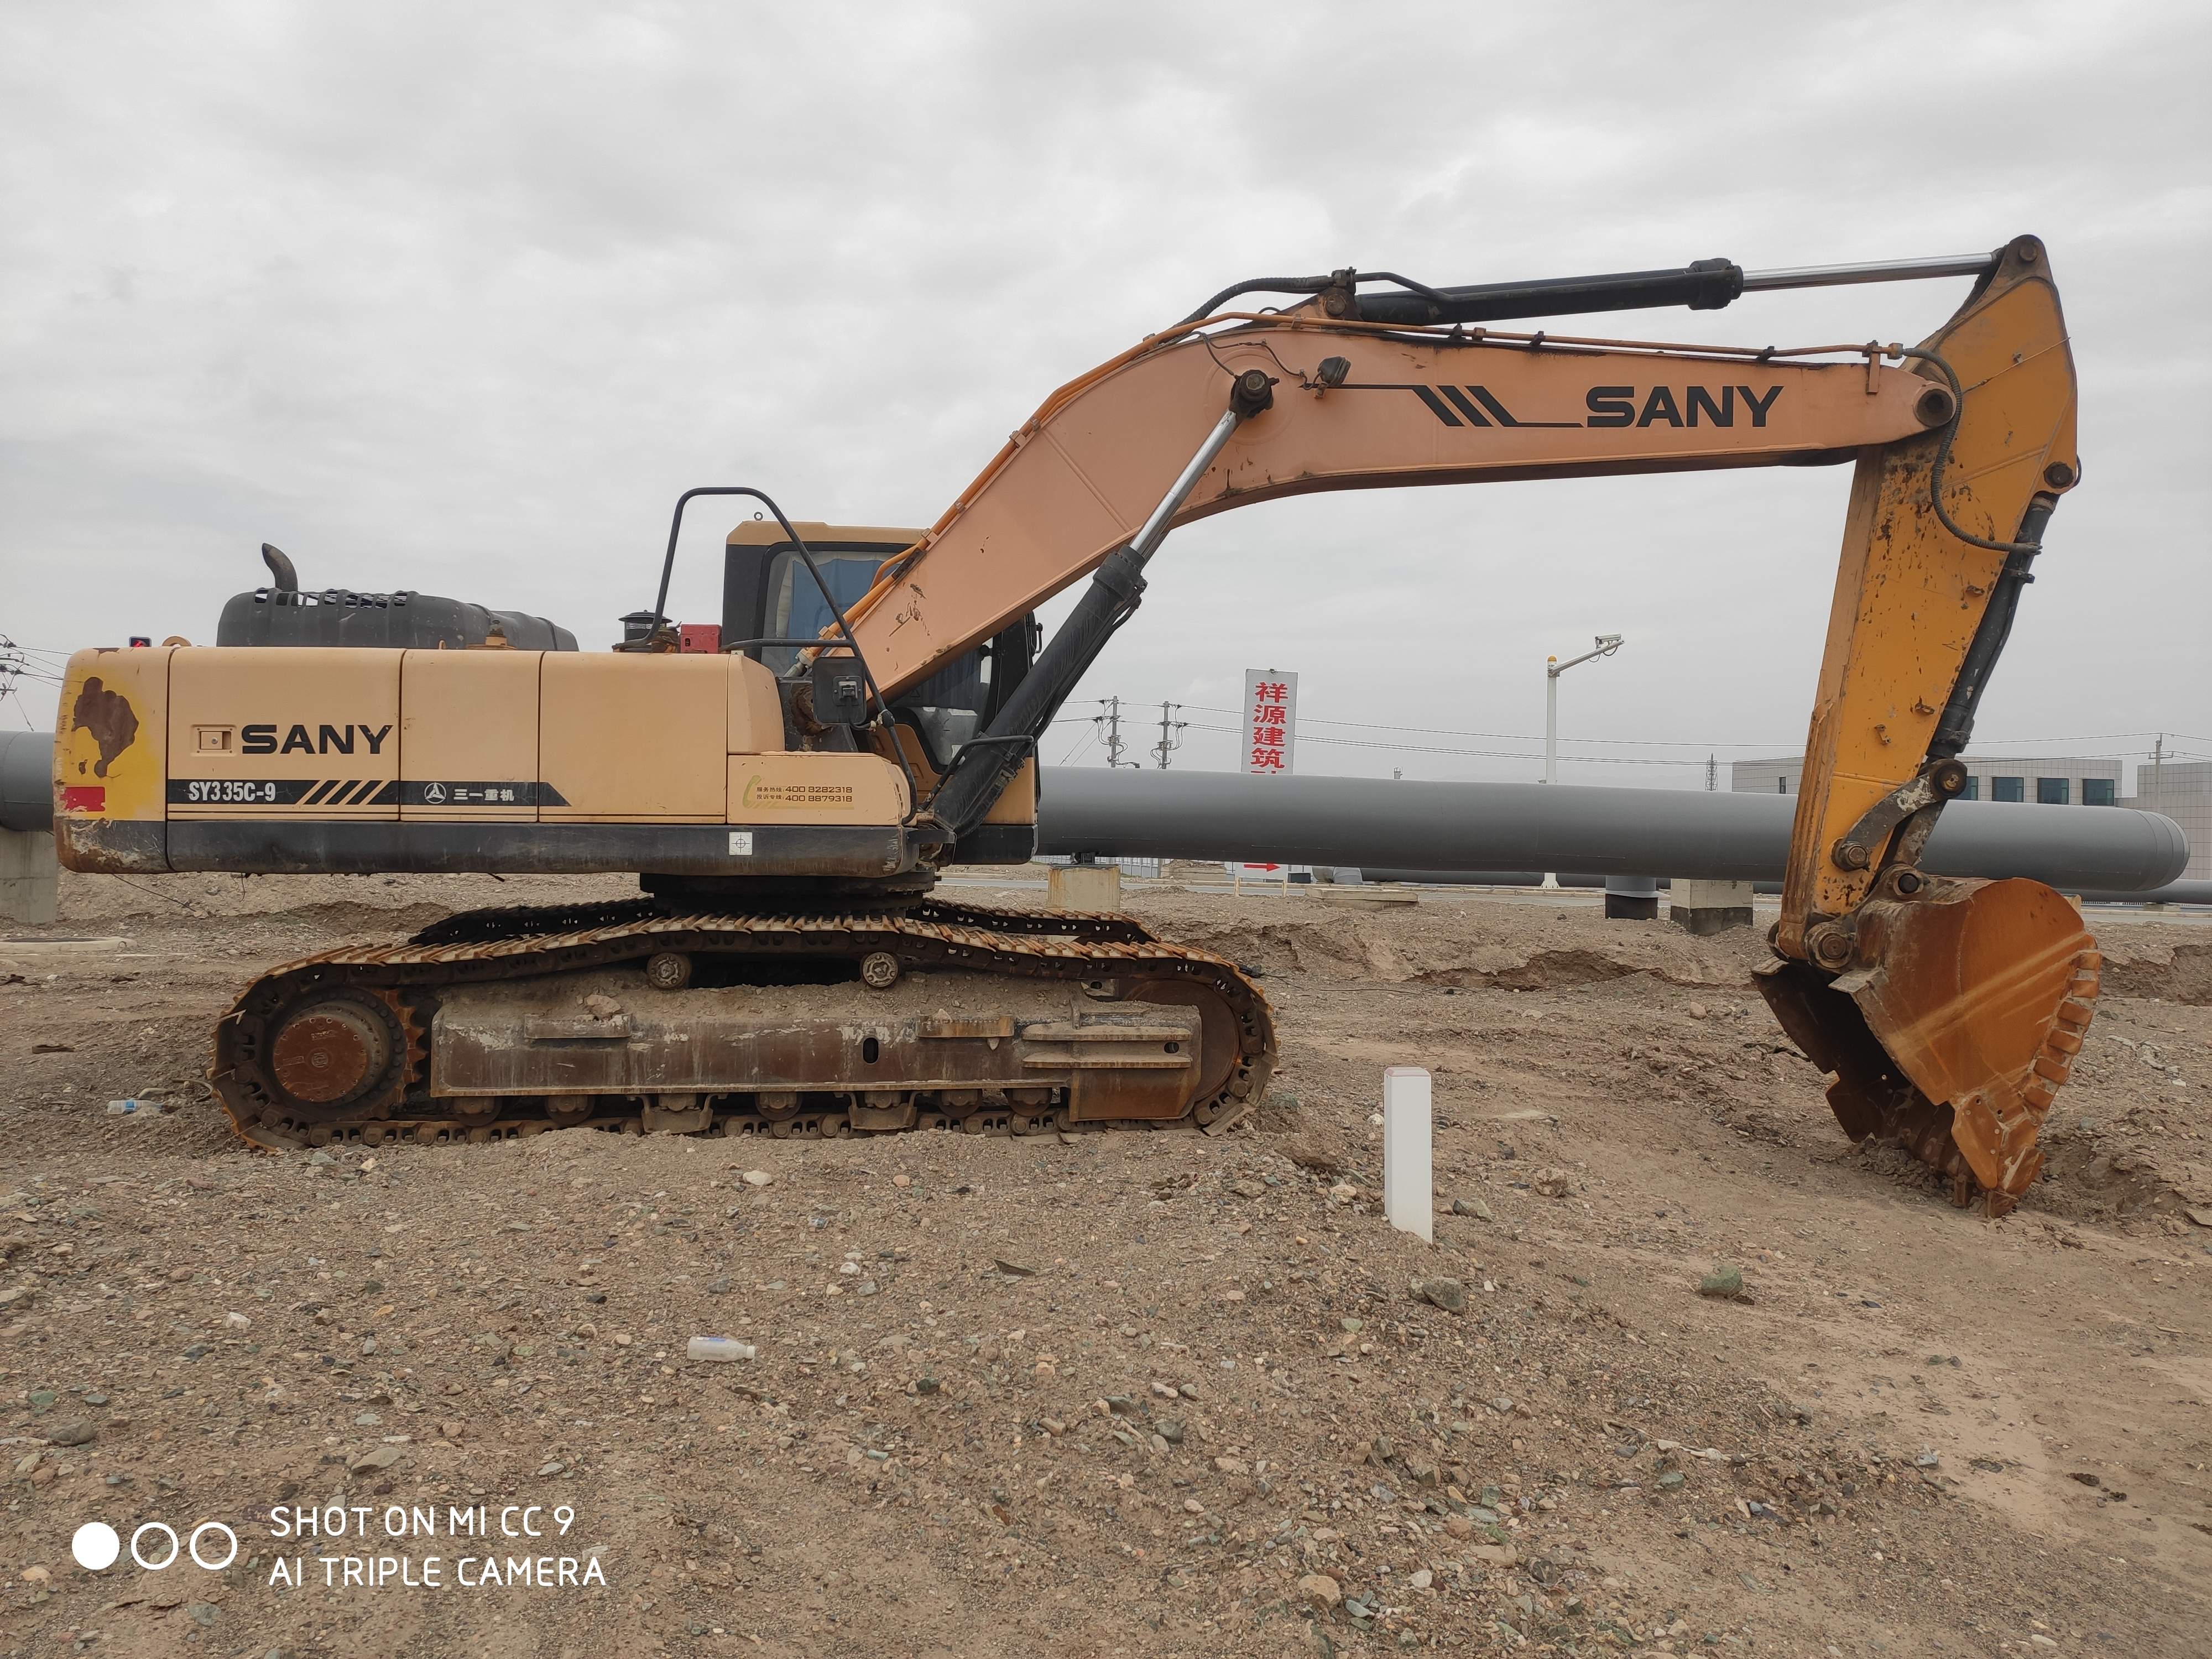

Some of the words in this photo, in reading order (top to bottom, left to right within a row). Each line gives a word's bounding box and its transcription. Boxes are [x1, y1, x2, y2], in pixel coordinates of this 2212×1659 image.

[1587, 385, 1784, 427] SANY
[242, 724, 392, 754] SANY
[1250, 682, 1288, 774] 祥源建筑
[188, 781, 276, 802] SY335C-9
[453, 789, 514, 801] 三一重机
